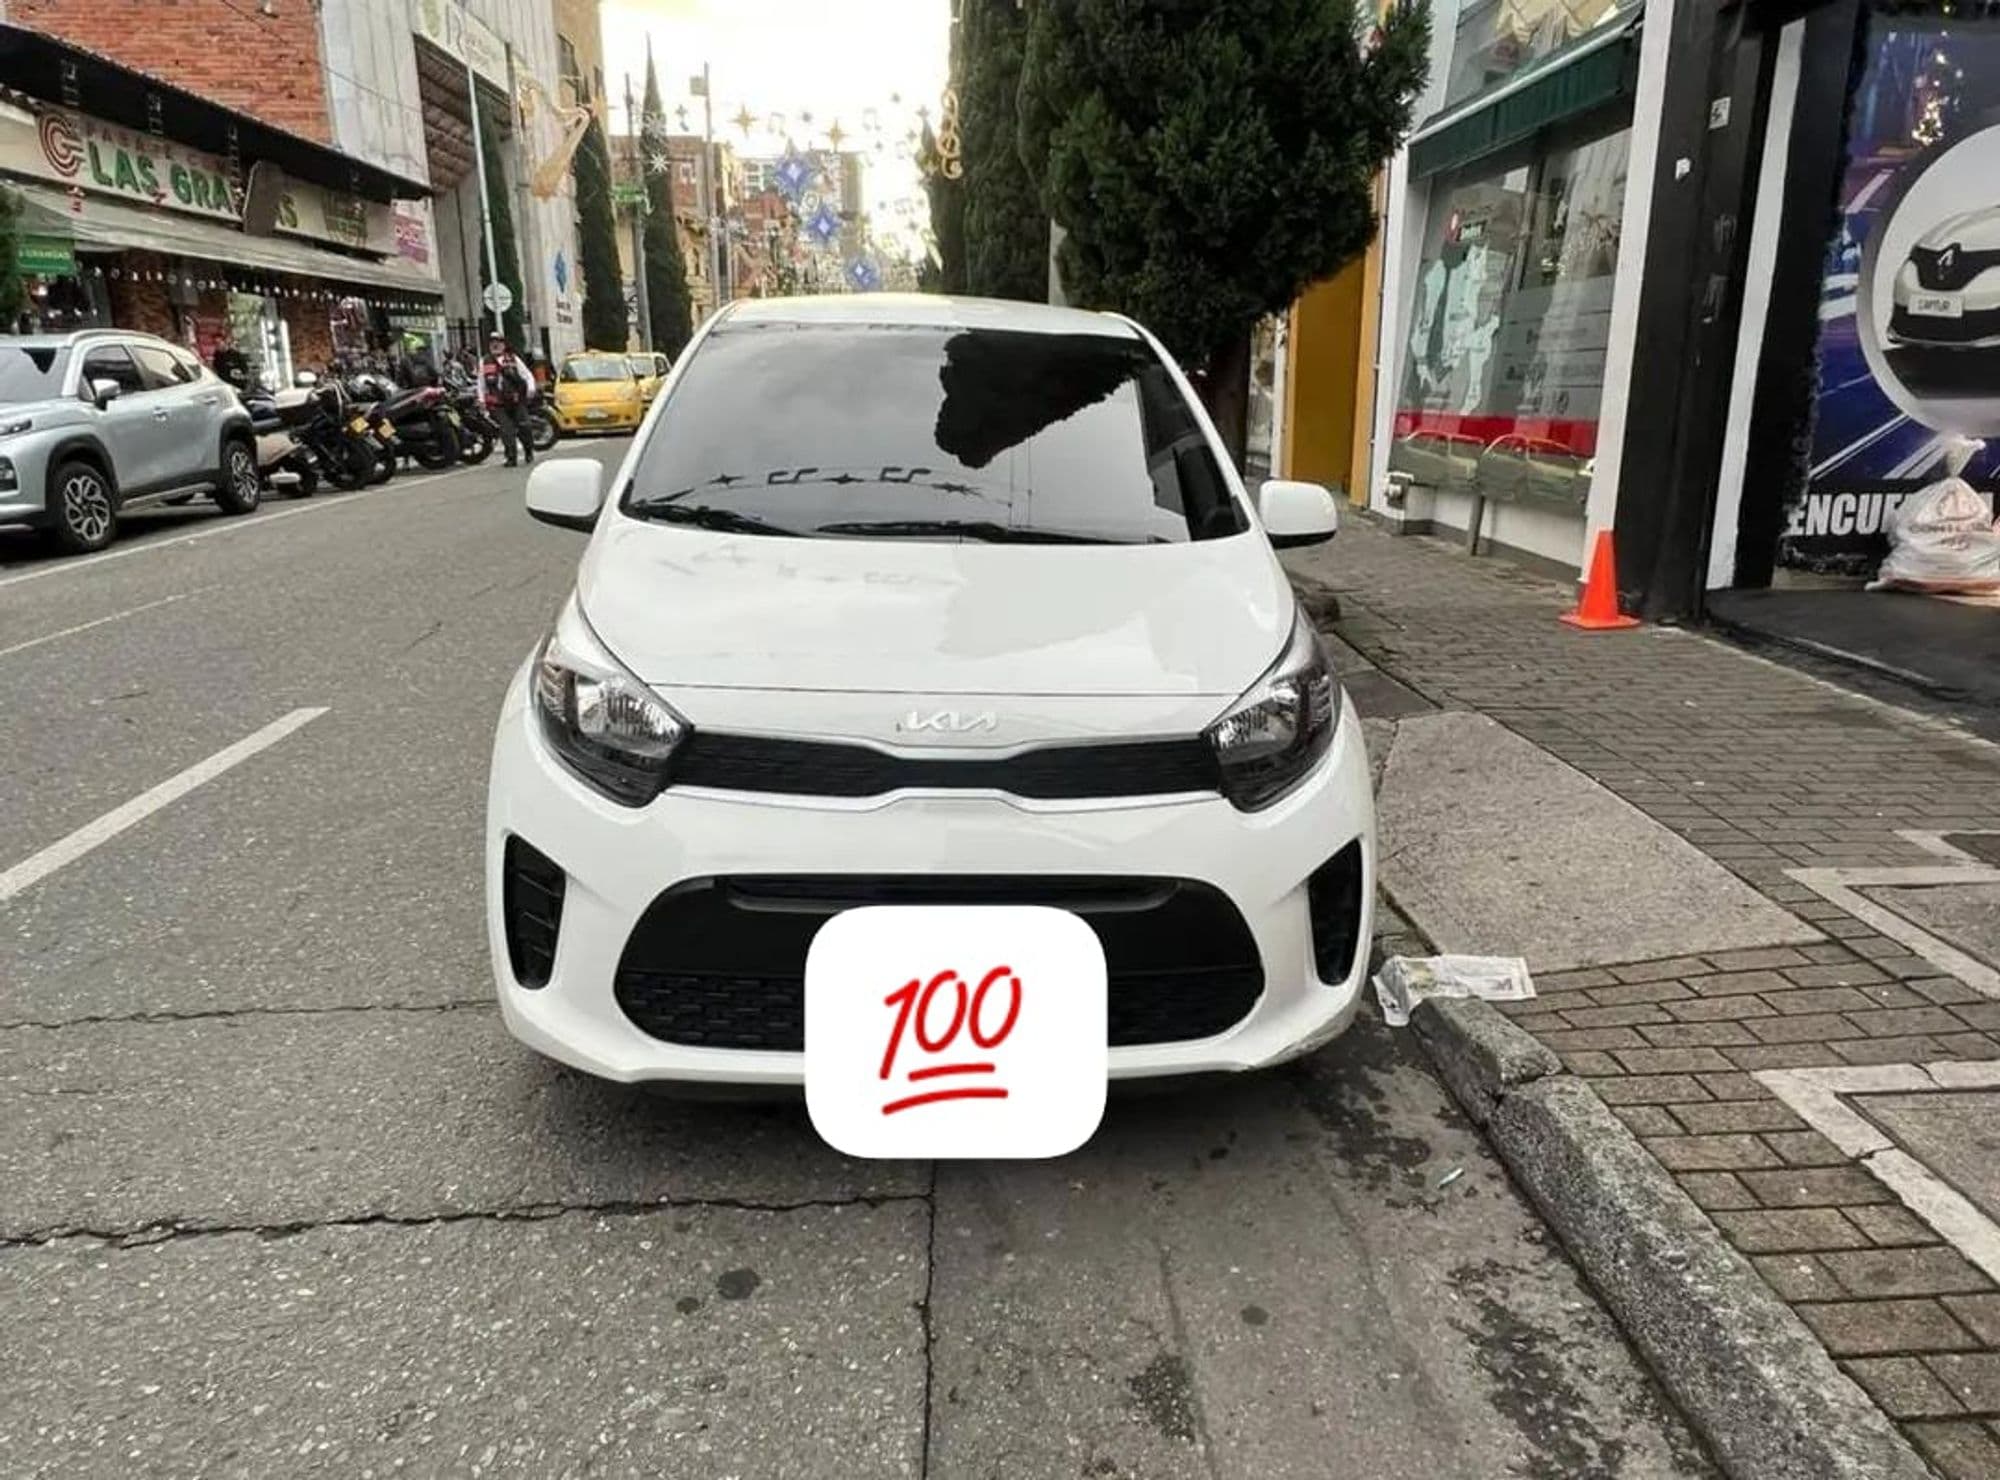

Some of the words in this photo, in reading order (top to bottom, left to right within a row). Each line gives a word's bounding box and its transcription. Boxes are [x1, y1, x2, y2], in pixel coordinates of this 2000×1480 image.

[87, 140, 161, 196] LAS
[169, 162, 240, 214] GRA
[905, 711, 997, 732] KIA
